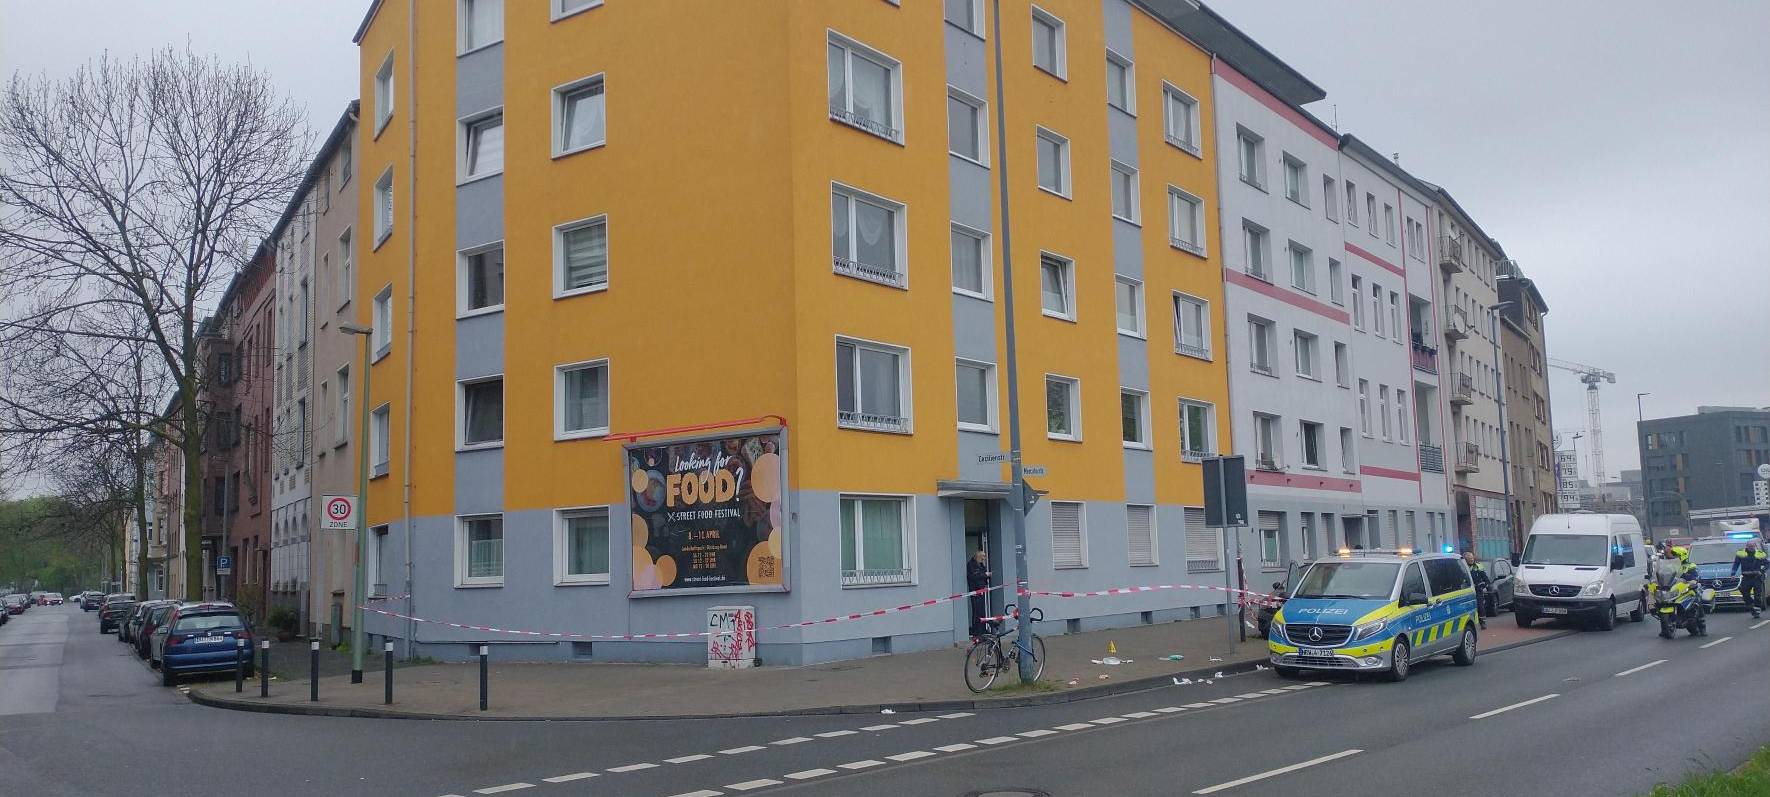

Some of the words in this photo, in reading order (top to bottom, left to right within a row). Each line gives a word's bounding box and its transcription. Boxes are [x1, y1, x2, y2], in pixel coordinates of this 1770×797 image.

[675, 452, 711, 484] Looking
[714, 451, 732, 476] for
[332, 504, 346, 515] 30
[698, 510, 713, 519] FOOD
[715, 508, 741, 518] FESTIVAL
[220, 558, 228, 568] P
[1415, 612, 1431, 623] POLIZEI
